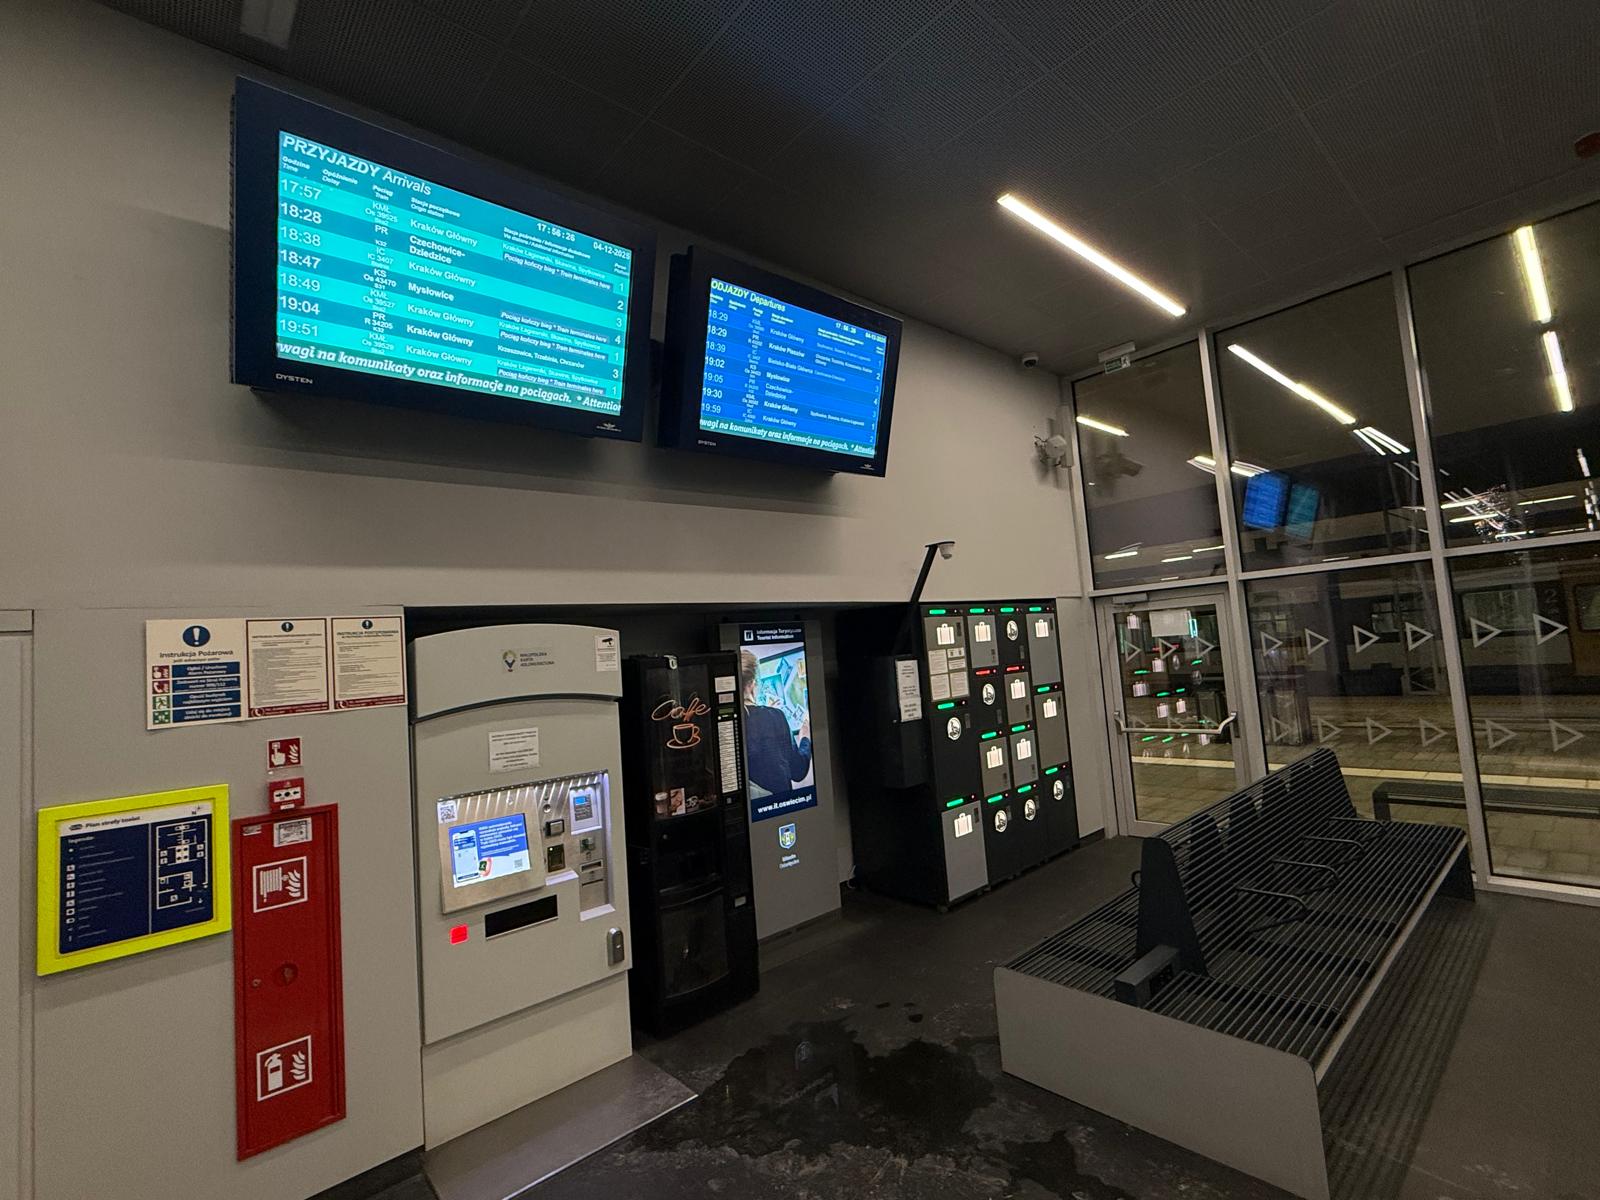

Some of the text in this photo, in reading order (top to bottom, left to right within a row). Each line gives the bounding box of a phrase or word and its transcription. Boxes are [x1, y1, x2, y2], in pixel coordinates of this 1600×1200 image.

[282, 135, 432, 195] PRZYJAZDY Arrivals
[280, 179, 322, 200] 17:57
[280, 202, 322, 225] 18:28
[280, 226, 322, 247] 18:38
[374, 224, 389, 236] PR
[410, 219, 478, 247] Kraków Główny
[409, 235, 466, 257] Czechowice-
[409, 245, 452, 264] Dziedzice
[280, 249, 321, 269] 18:47
[280, 273, 321, 292] 18:49
[409, 261, 443, 278] Kraków
[444, 271, 476, 287] Główny
[280, 296, 321, 315] 19:04
[617, 300, 624, 310] 2
[711, 280, 750, 299] ODJAZDY
[749, 292, 787, 312] Departures
[372, 312, 386, 321] PR
[407, 304, 474, 327] Kraków Główny
[616, 318, 622, 328] 3
[280, 319, 319, 336] 19:51
[406, 324, 474, 347] Kraków Główny
[707, 324, 728, 338] 18:29
[614, 335, 621, 345] 4
[405, 344, 473, 366] Kraków Główny
[705, 356, 725, 369] 19:02
[317, 350, 337, 362] na
[339, 352, 416, 377] komunikaty
[416, 367, 444, 380] oraz
[445, 371, 503, 392] informacje
[504, 384, 519, 394] na
[520, 384, 572, 403] pociągach.
[612, 369, 619, 378] 3
[703, 387, 723, 399] 19:30
[719, 422, 729, 430] na
[729, 422, 768, 437] komunikaty
[767, 429, 782, 438] oraz
[782, 431, 813, 445] informacje
